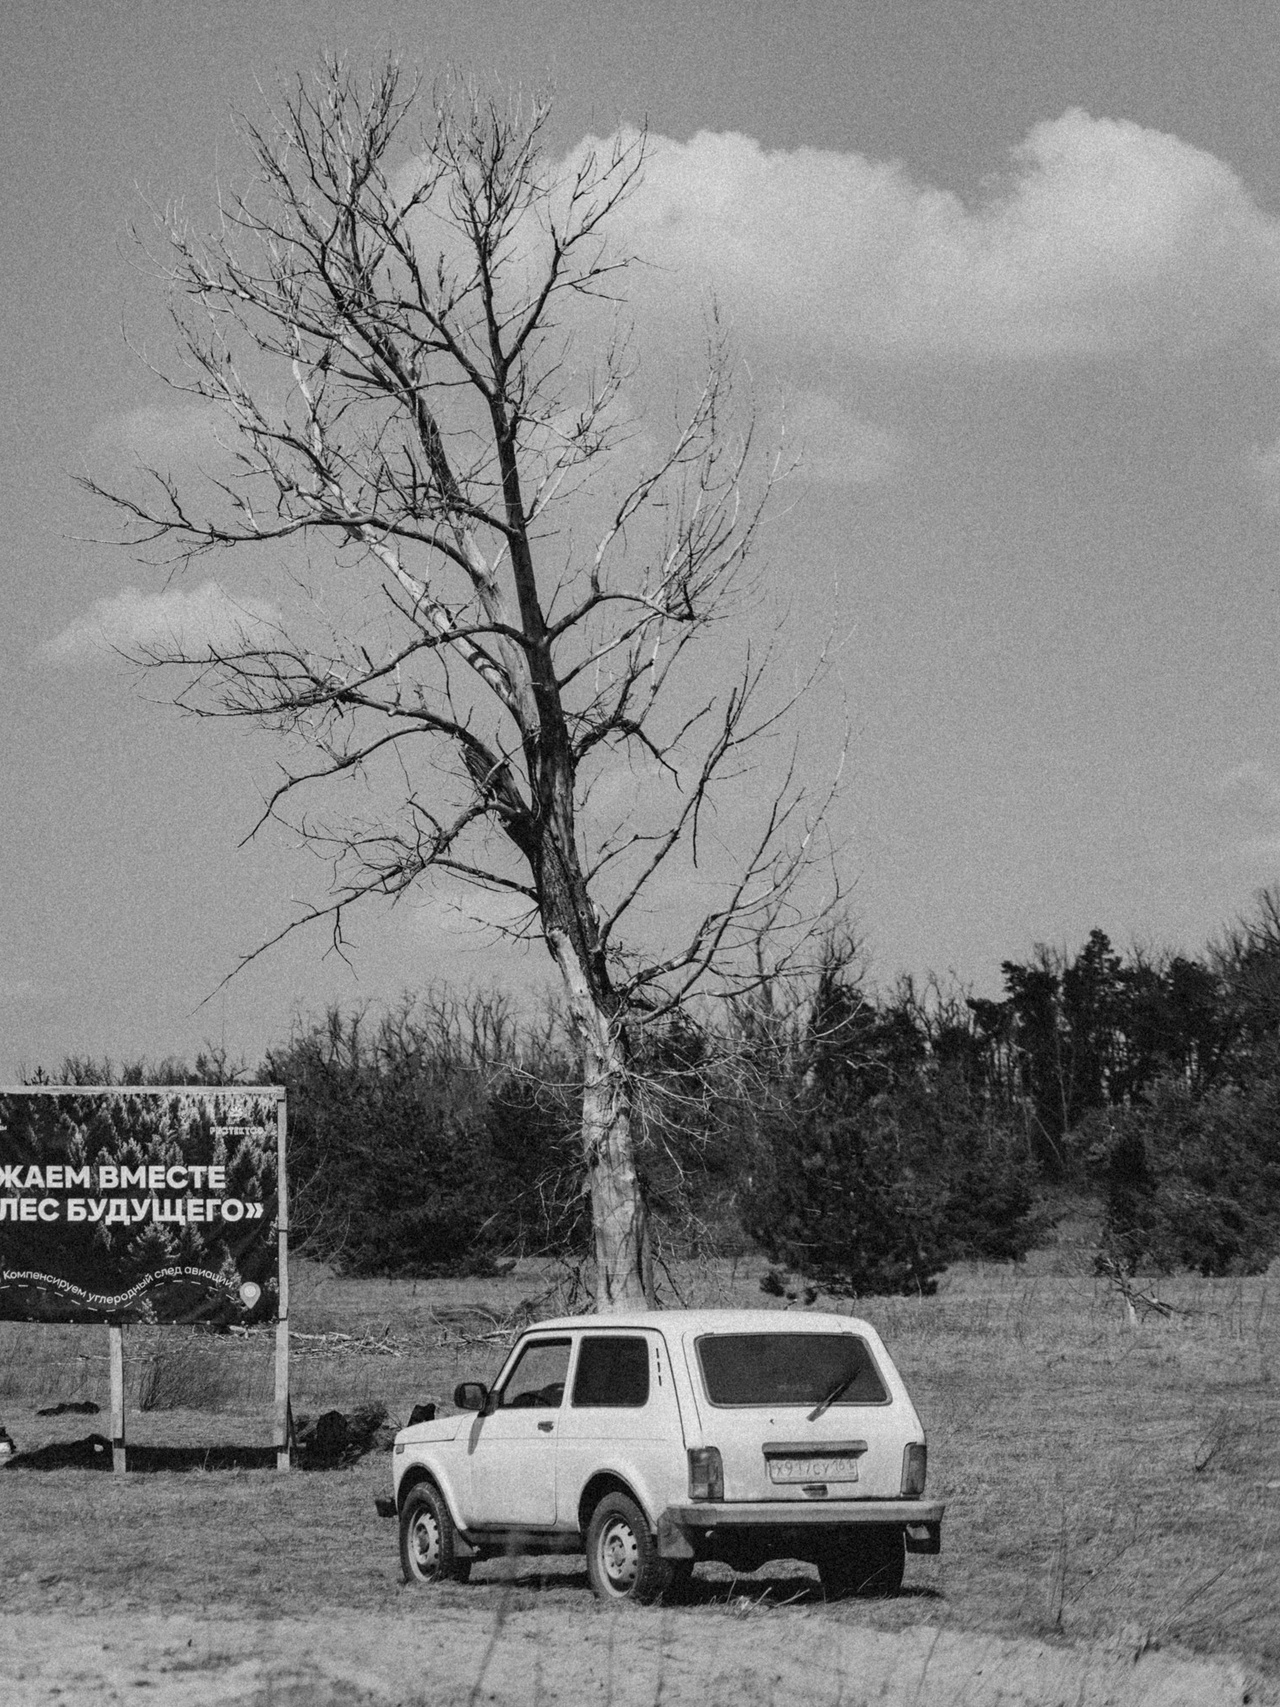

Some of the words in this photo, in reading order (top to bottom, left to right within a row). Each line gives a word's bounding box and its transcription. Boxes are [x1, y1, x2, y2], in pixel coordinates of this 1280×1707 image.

[99, 1165, 226, 1188] ВМЕСТЕ
[67, 1198, 264, 1225] БУДУЩЕГО»
[2, 1270, 87, 1297] Компенсируем
[86, 1273, 153, 1305] углеродный
[154, 1266, 182, 1279] след
[184, 1266, 233, 1288] авиации
